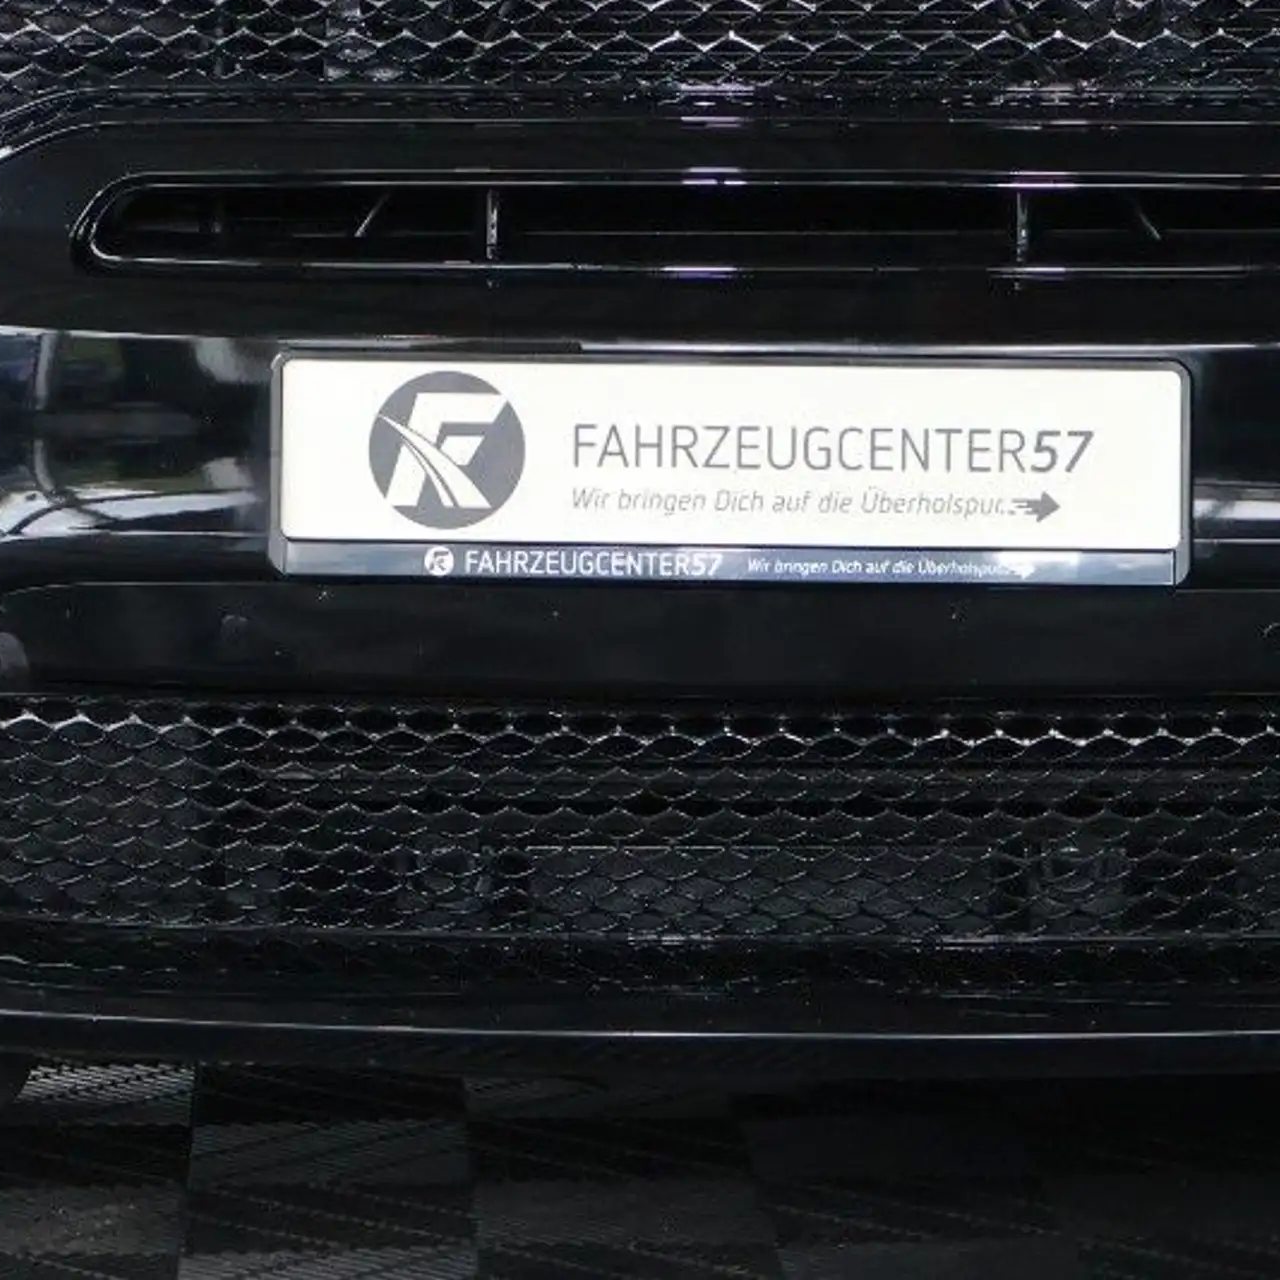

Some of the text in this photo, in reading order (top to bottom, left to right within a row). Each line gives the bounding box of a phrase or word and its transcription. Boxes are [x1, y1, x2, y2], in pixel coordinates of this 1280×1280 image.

[573, 423, 1095, 473] FAHRZEUGCENTER57
[572, 487, 614, 510] Wir
[618, 487, 707, 517] bringen
[714, 488, 764, 513] Dich
[772, 489, 812, 514] auf
[818, 490, 853, 514] die
[464, 550, 724, 577] FAHRZEUGCENTER57
[748, 557, 771, 573] Wir
[774, 557, 828, 576] bringen
[831, 558, 862, 574] Dich
[865, 559, 890, 574] auf
[891, 559, 915, 575] die
